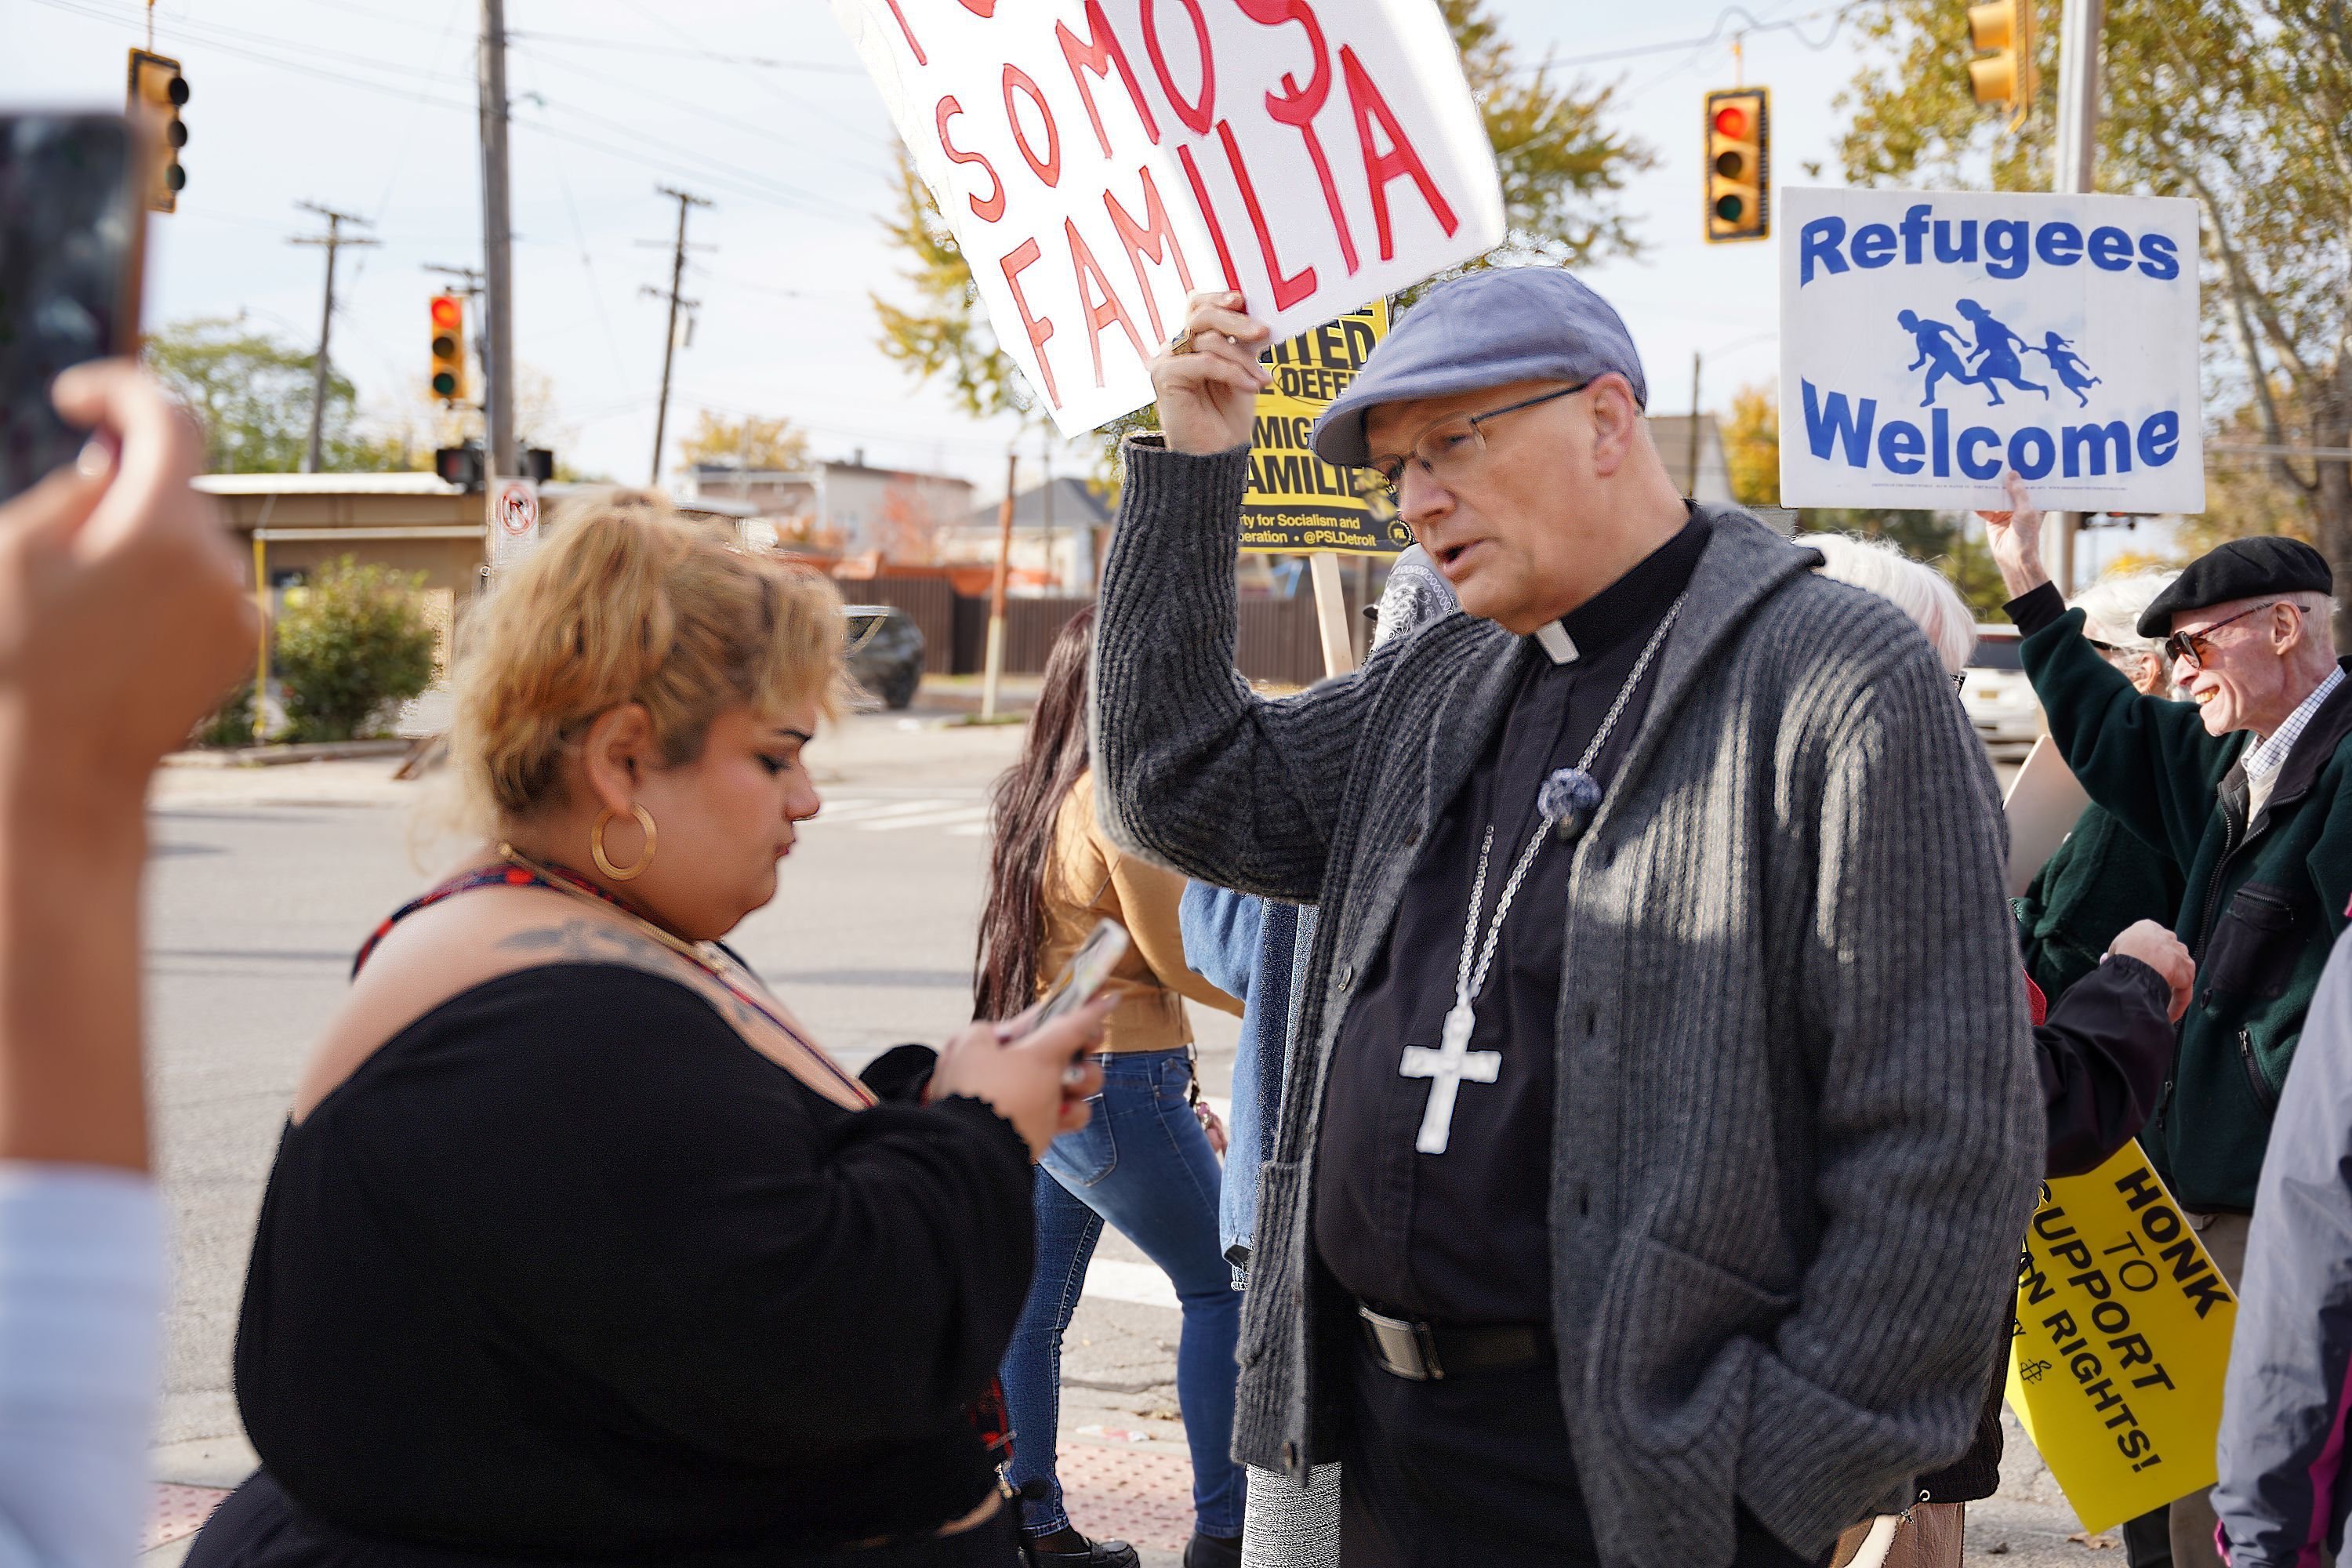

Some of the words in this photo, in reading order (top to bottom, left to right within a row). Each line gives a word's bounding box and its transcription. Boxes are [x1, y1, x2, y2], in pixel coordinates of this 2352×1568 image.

[936, 0, 1333, 223] SOMOS
[1000, 44, 1459, 409] FAMILIA
[1800, 204, 2180, 288] Refugees
[1801, 376, 2180, 481] Welcome
[1257, 514, 1275, 527] for
[1277, 514, 1338, 528] Socialism
[1341, 517, 1361, 529] and
[1303, 531, 1377, 546] @PSLDetroit
[2103, 1231, 2158, 1292] TO
[2114, 1167, 2231, 1319] HONK
[2042, 1309, 2161, 1473] RIGHTS!
